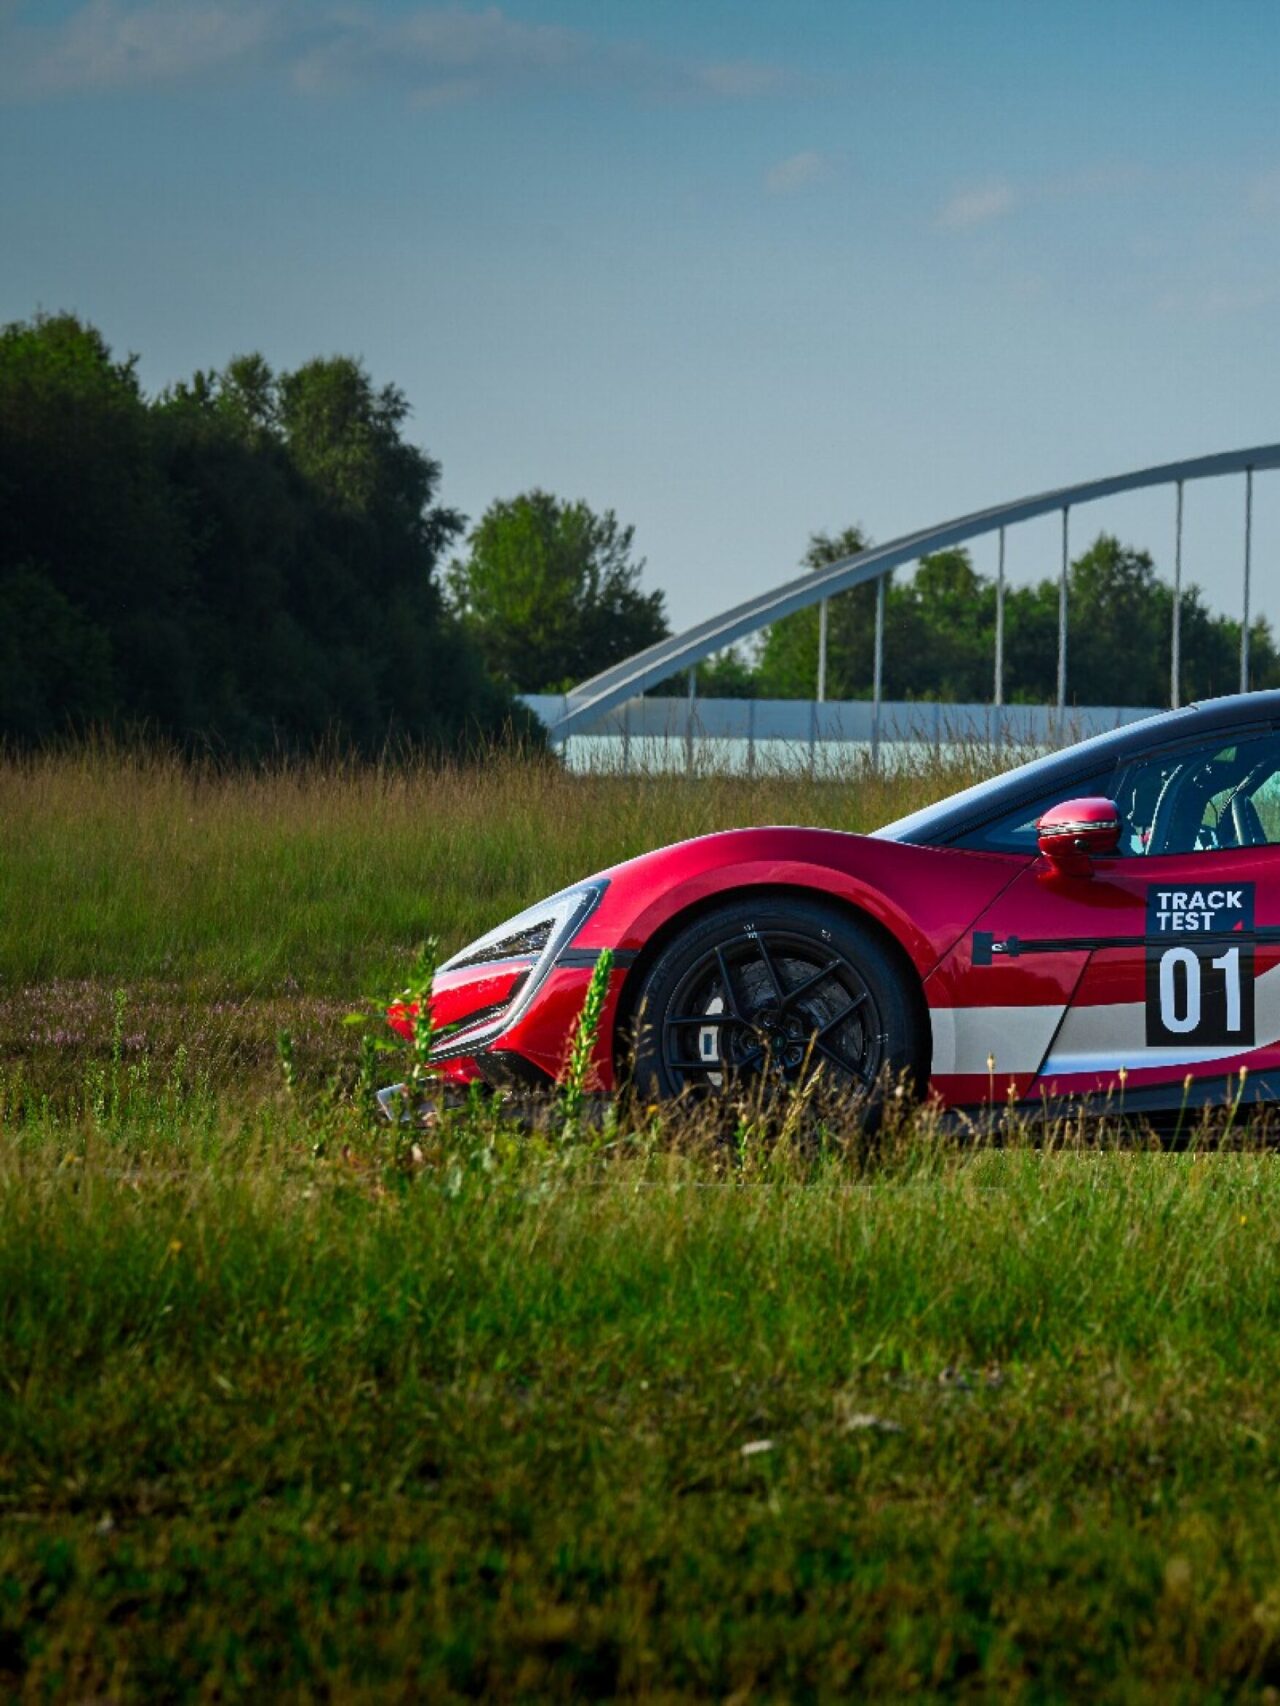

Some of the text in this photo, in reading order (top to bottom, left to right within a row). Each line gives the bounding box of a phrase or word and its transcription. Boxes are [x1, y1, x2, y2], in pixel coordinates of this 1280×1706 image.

[1157, 891, 1243, 910] TRACK
[1156, 912, 1215, 931] TEST
[1159, 947, 1241, 1033] 01
